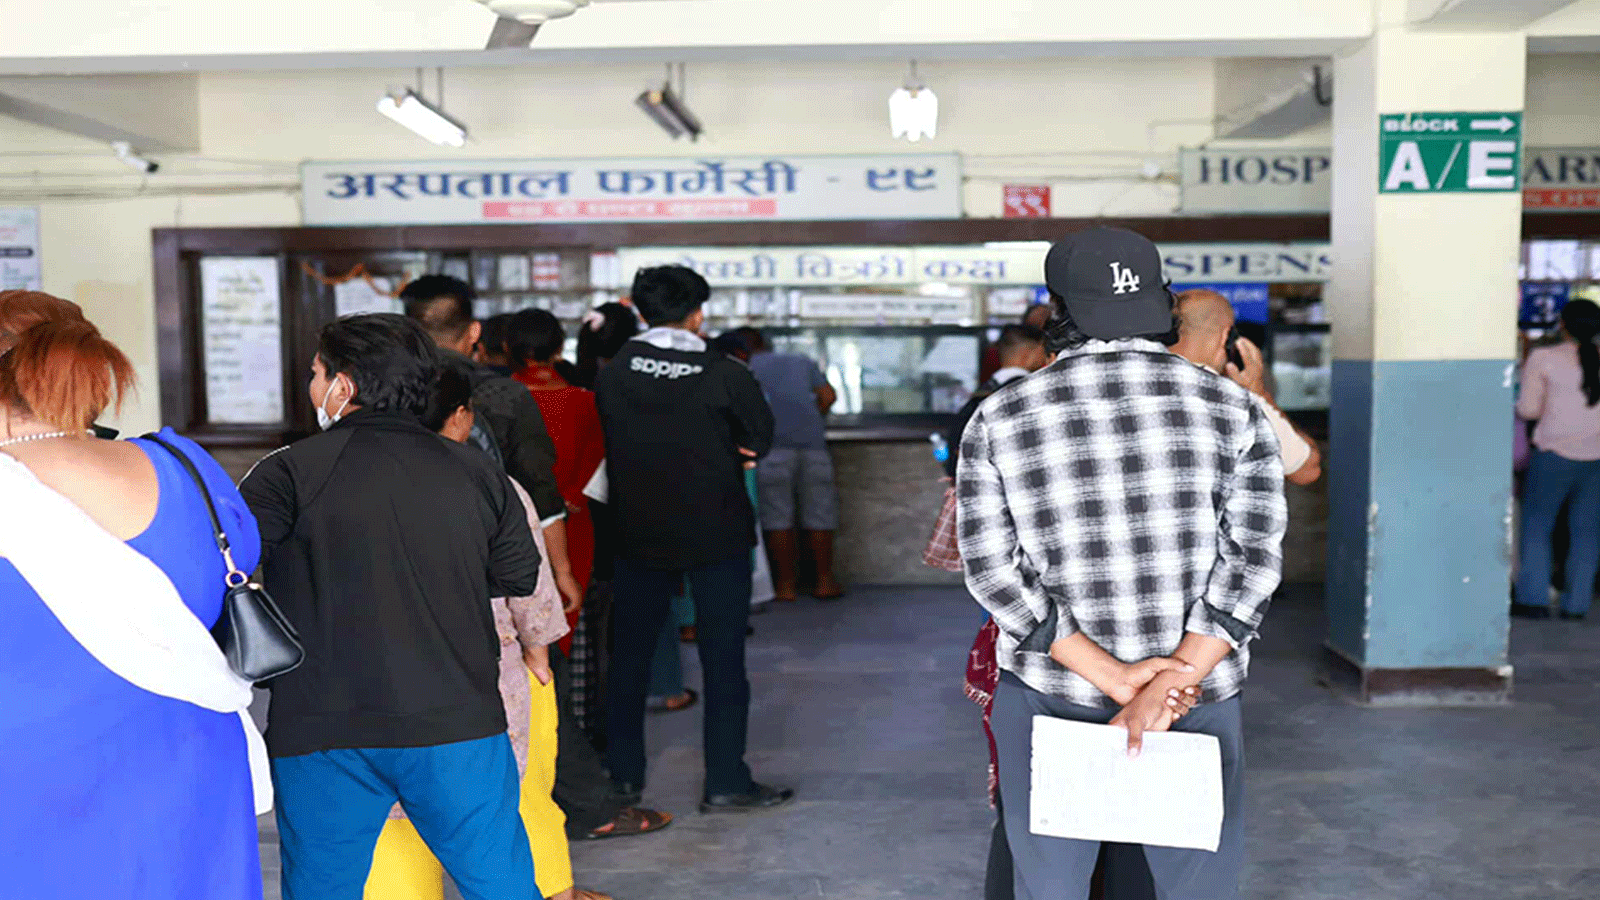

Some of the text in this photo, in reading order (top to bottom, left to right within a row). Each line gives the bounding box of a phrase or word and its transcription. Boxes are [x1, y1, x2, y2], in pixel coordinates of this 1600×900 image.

[1384, 118, 1460, 132] BLOCK
[1384, 140, 1516, 190] A/E
[323, 170, 572, 199] अस्पताल
[1109, 261, 1140, 294] LA
